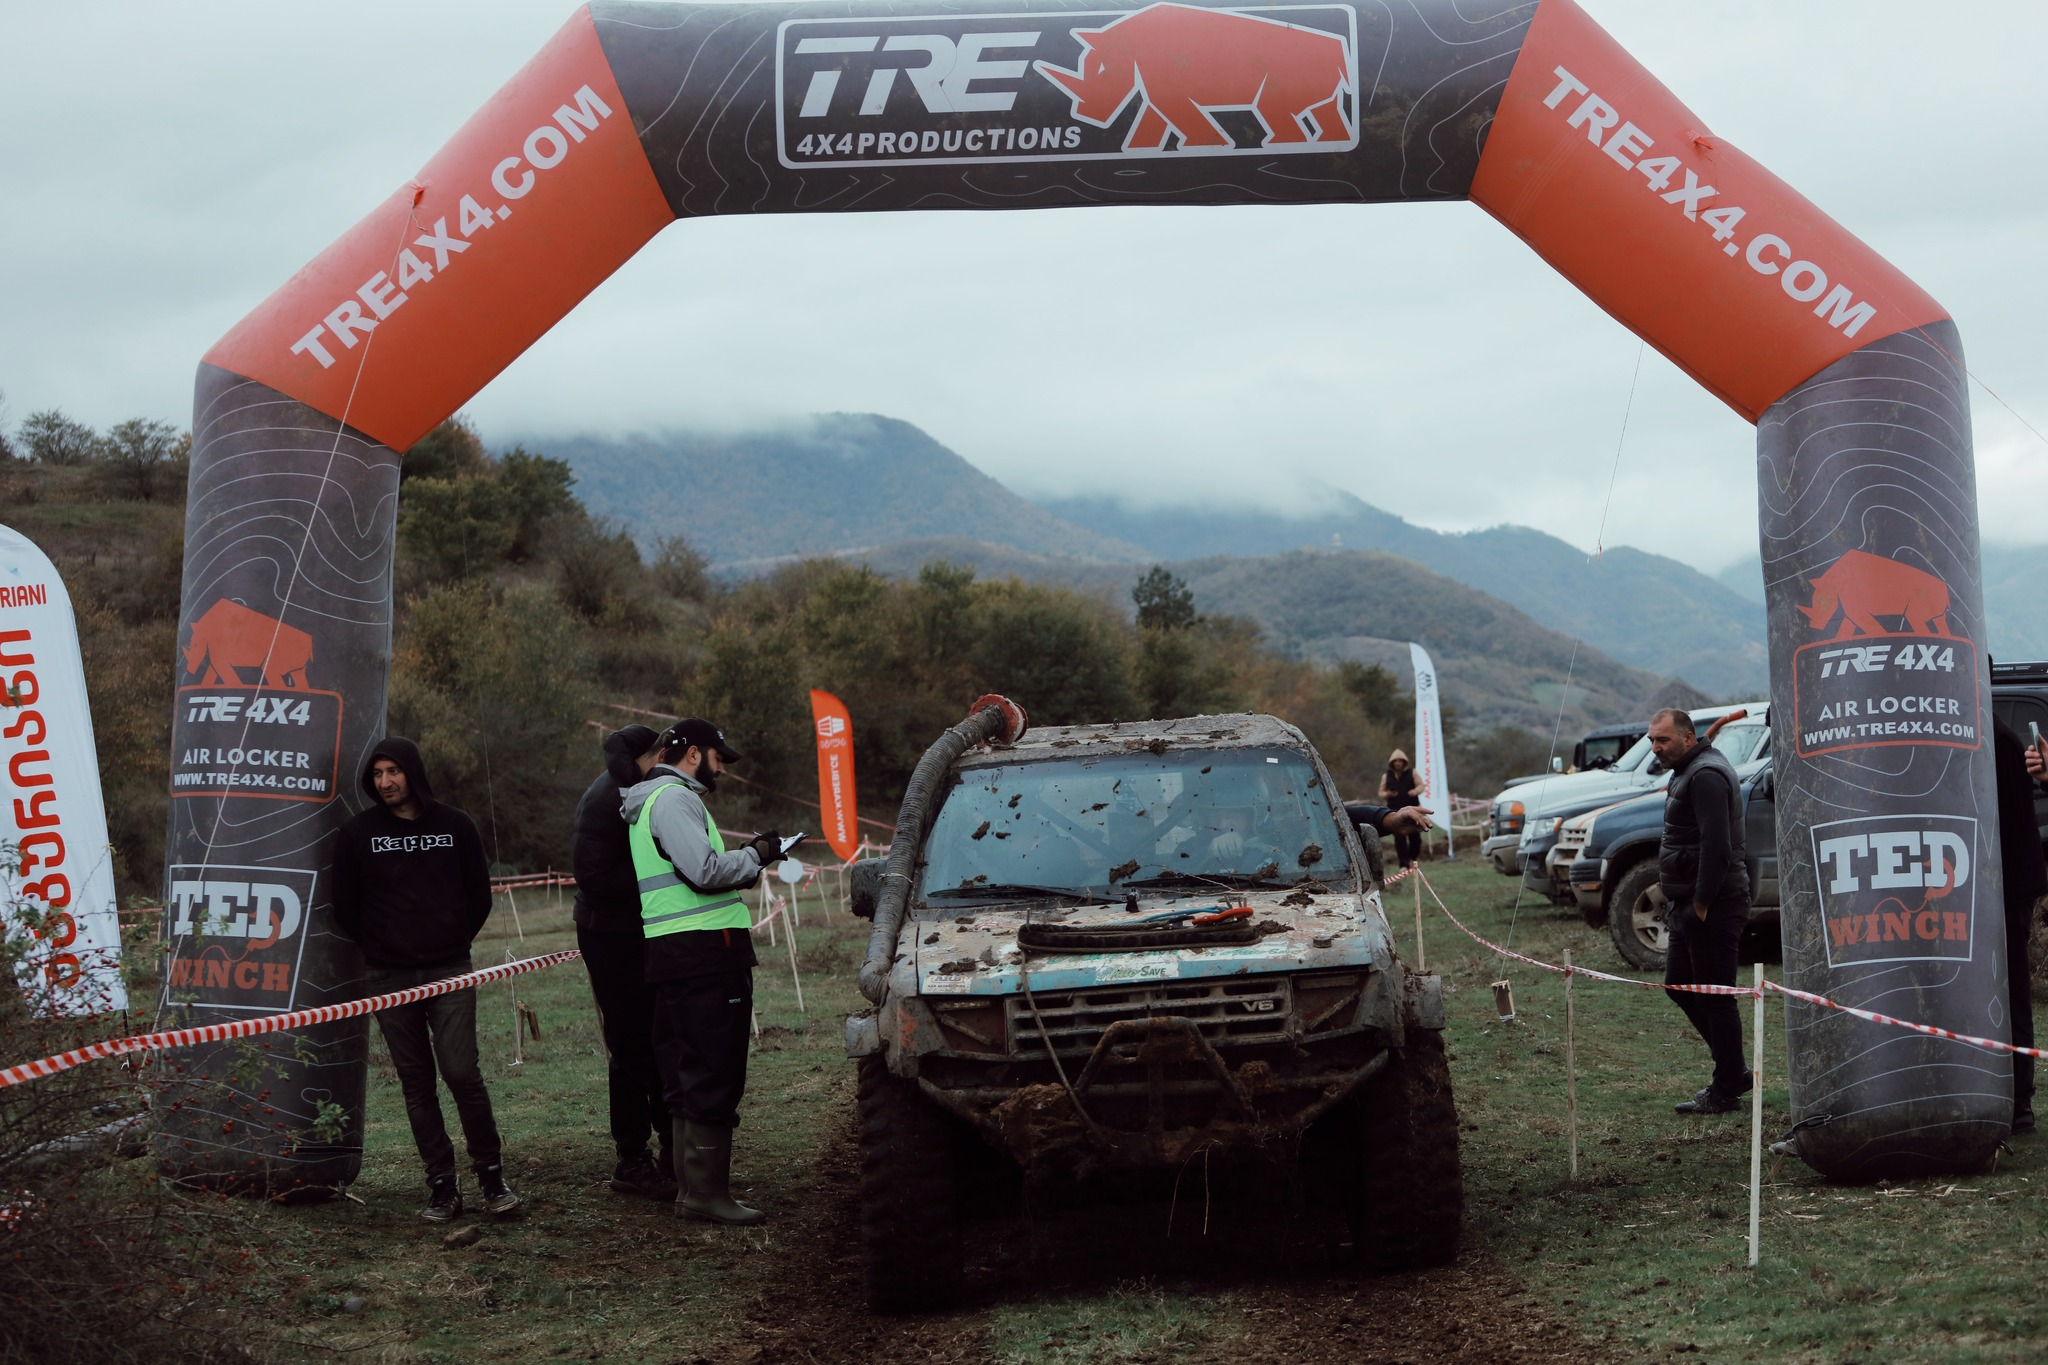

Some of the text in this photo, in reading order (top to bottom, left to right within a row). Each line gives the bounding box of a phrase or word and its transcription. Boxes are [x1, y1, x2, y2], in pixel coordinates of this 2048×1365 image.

[794, 31, 1042, 118] TRE
[1542, 65, 1877, 339] TRE4X4.COM
[289, 84, 613, 369] TRE4X4.COM
[1819, 644, 1955, 679] TRE 4X4
[187, 696, 311, 726] TRE 4X4
[1818, 696, 1961, 722] AIR LOCKER
[1804, 721, 1974, 746] WWW.TRE4X4.COM
[182, 748, 310, 769] AIR LOCKER
[174, 772, 326, 792] WWW.TRE4X4.COM
[371, 834, 453, 853] Kappa
[1819, 830, 1970, 895] TED
[171, 880, 301, 940] TED
[1827, 911, 1968, 947] WINCH
[170, 959, 291, 992] WINCH
[1242, 999, 1275, 1012] V6
